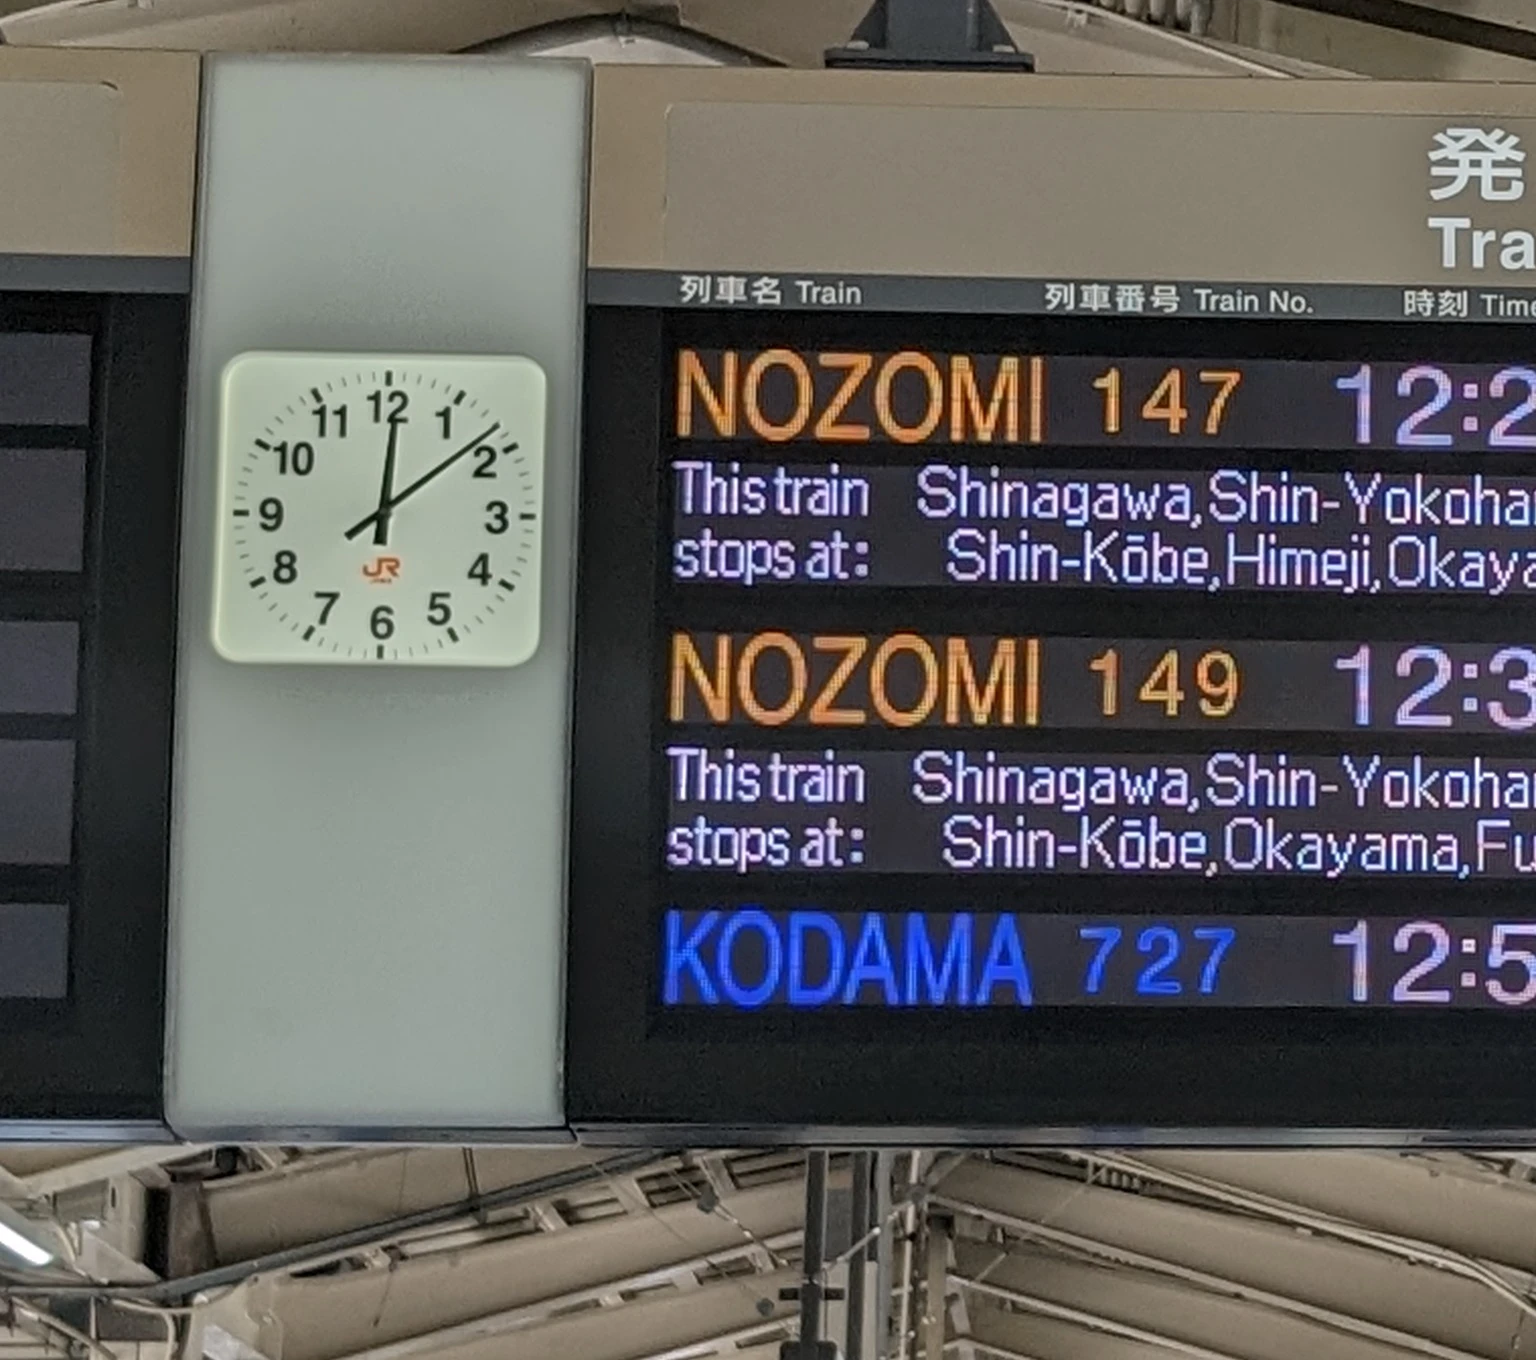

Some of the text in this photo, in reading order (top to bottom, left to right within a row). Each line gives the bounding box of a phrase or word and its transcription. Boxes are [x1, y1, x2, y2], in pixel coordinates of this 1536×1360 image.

[680, 275, 862, 306] 列車名 Train
[1045, 283, 1314, 314] 列車番号 Train No.
[1402, 290, 1469, 318] 時刻
[366, 390, 409, 424] 12
[676, 348, 1044, 443] NOZOMI
[1092, 367, 1241, 434] 147
[311, 404, 348, 438] 11
[435, 406, 452, 440] 1
[272, 441, 314, 476] 10
[472, 445, 498, 478] 2
[258, 497, 285, 532] 9
[484, 501, 510, 535] 3
[272, 550, 298, 584] 8
[363, 557, 400, 577] JR
[467, 552, 493, 586] 4
[674, 527, 796, 585] stops
[805, 530, 869, 578] at:
[314, 592, 340, 625] 7
[369, 605, 395, 640] 6
[426, 592, 452, 625] 5
[670, 631, 1040, 727] NOZOMI
[1091, 649, 1238, 718] 149
[667, 816, 791, 873] stops
[799, 817, 865, 866] at:
[662, 908, 1034, 1007] KODAMA
[1079, 927, 1236, 995] 727
